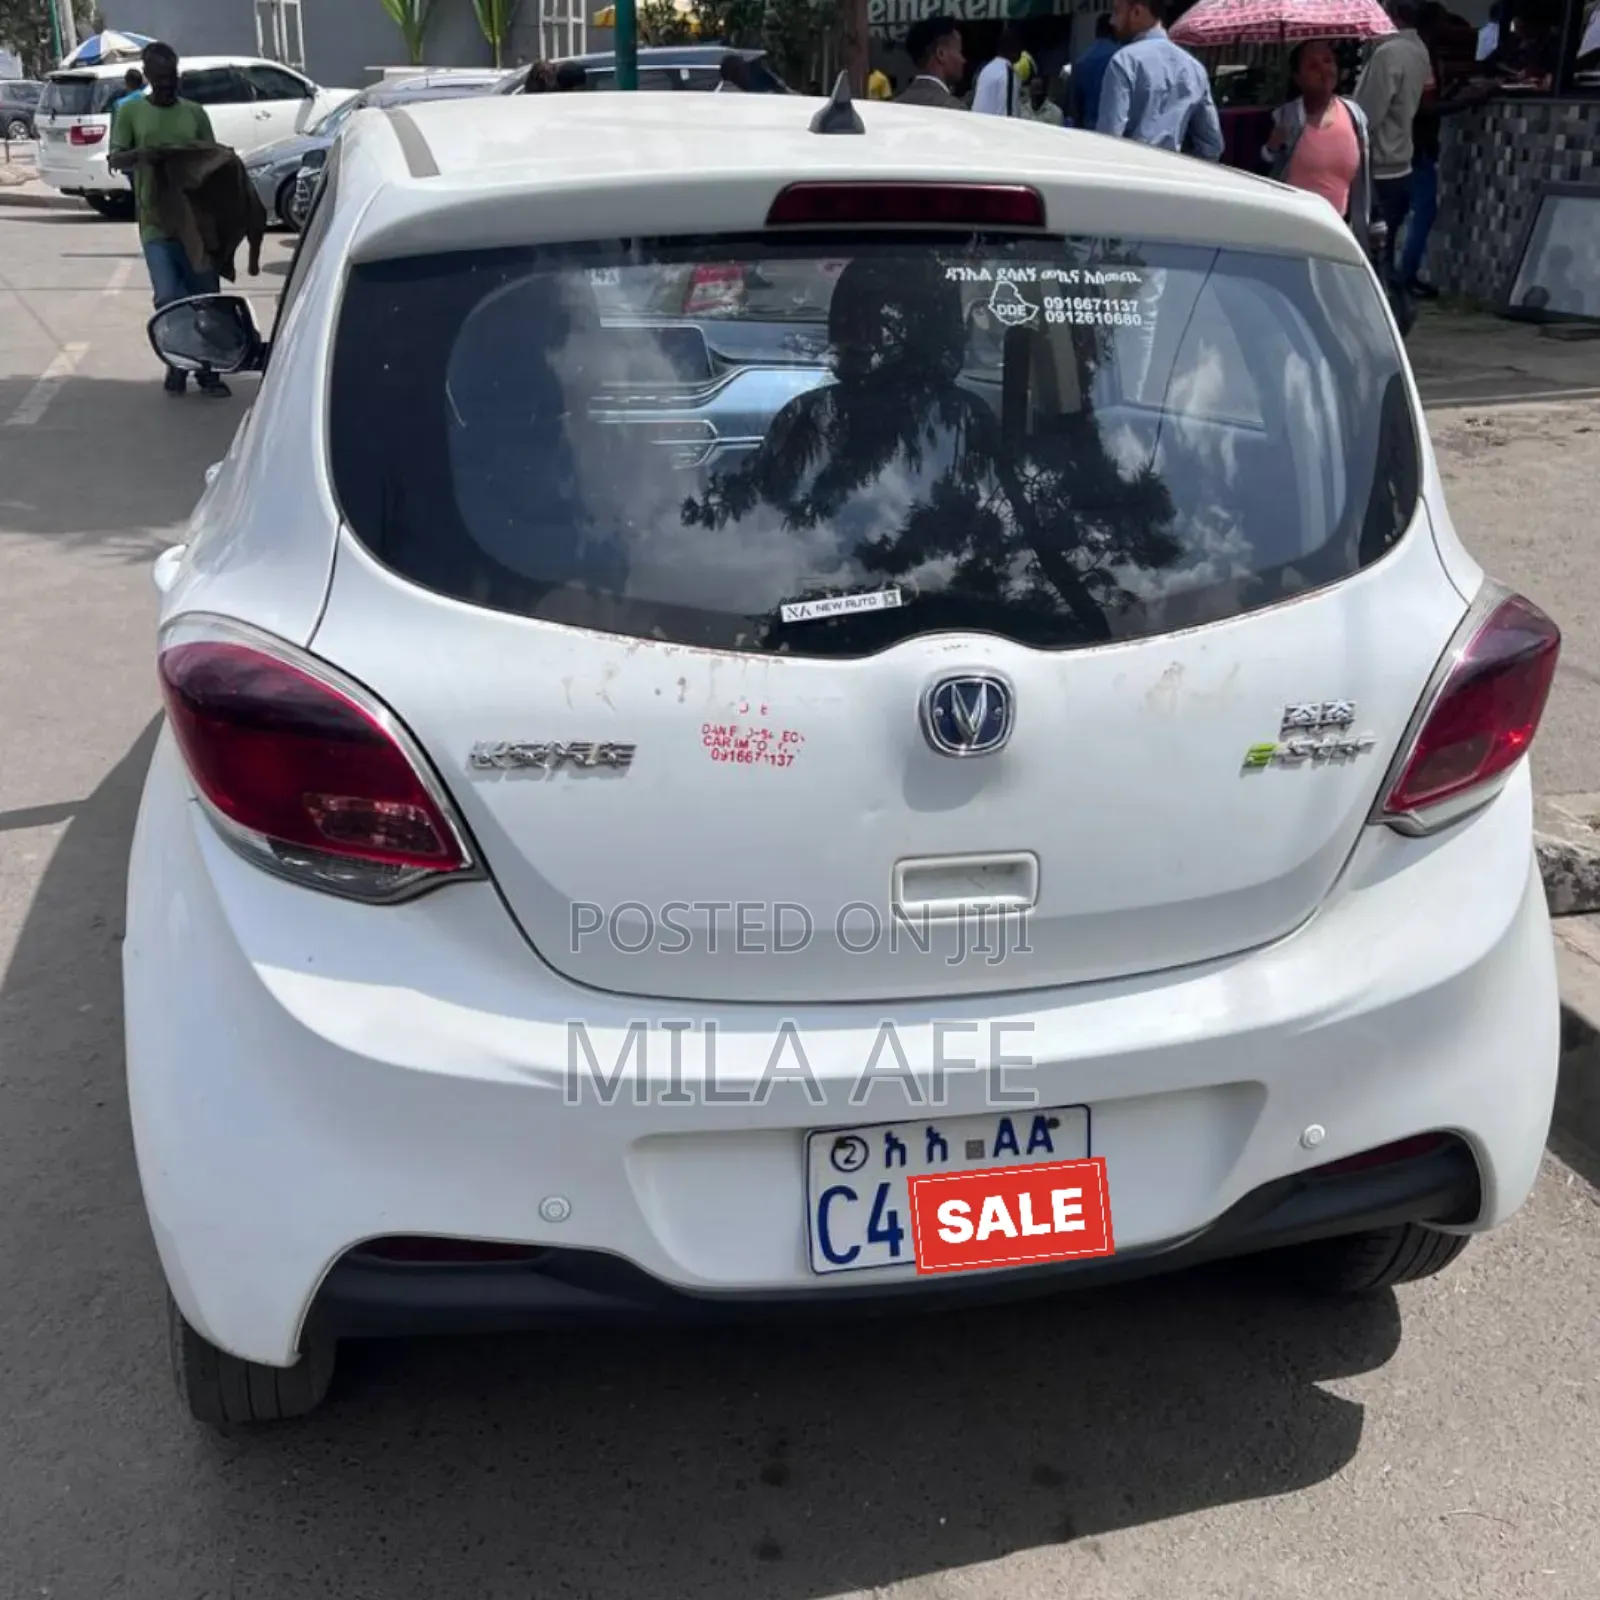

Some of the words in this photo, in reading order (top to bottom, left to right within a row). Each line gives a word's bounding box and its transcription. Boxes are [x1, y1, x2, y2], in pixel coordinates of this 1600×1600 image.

[867, 0, 1010, 24] eineken
[1042, 296, 1139, 312] 0916671137
[703, 735, 731, 748] CAR
[992, 1115, 1054, 1158] AA
[817, 1182, 905, 1265] C4
